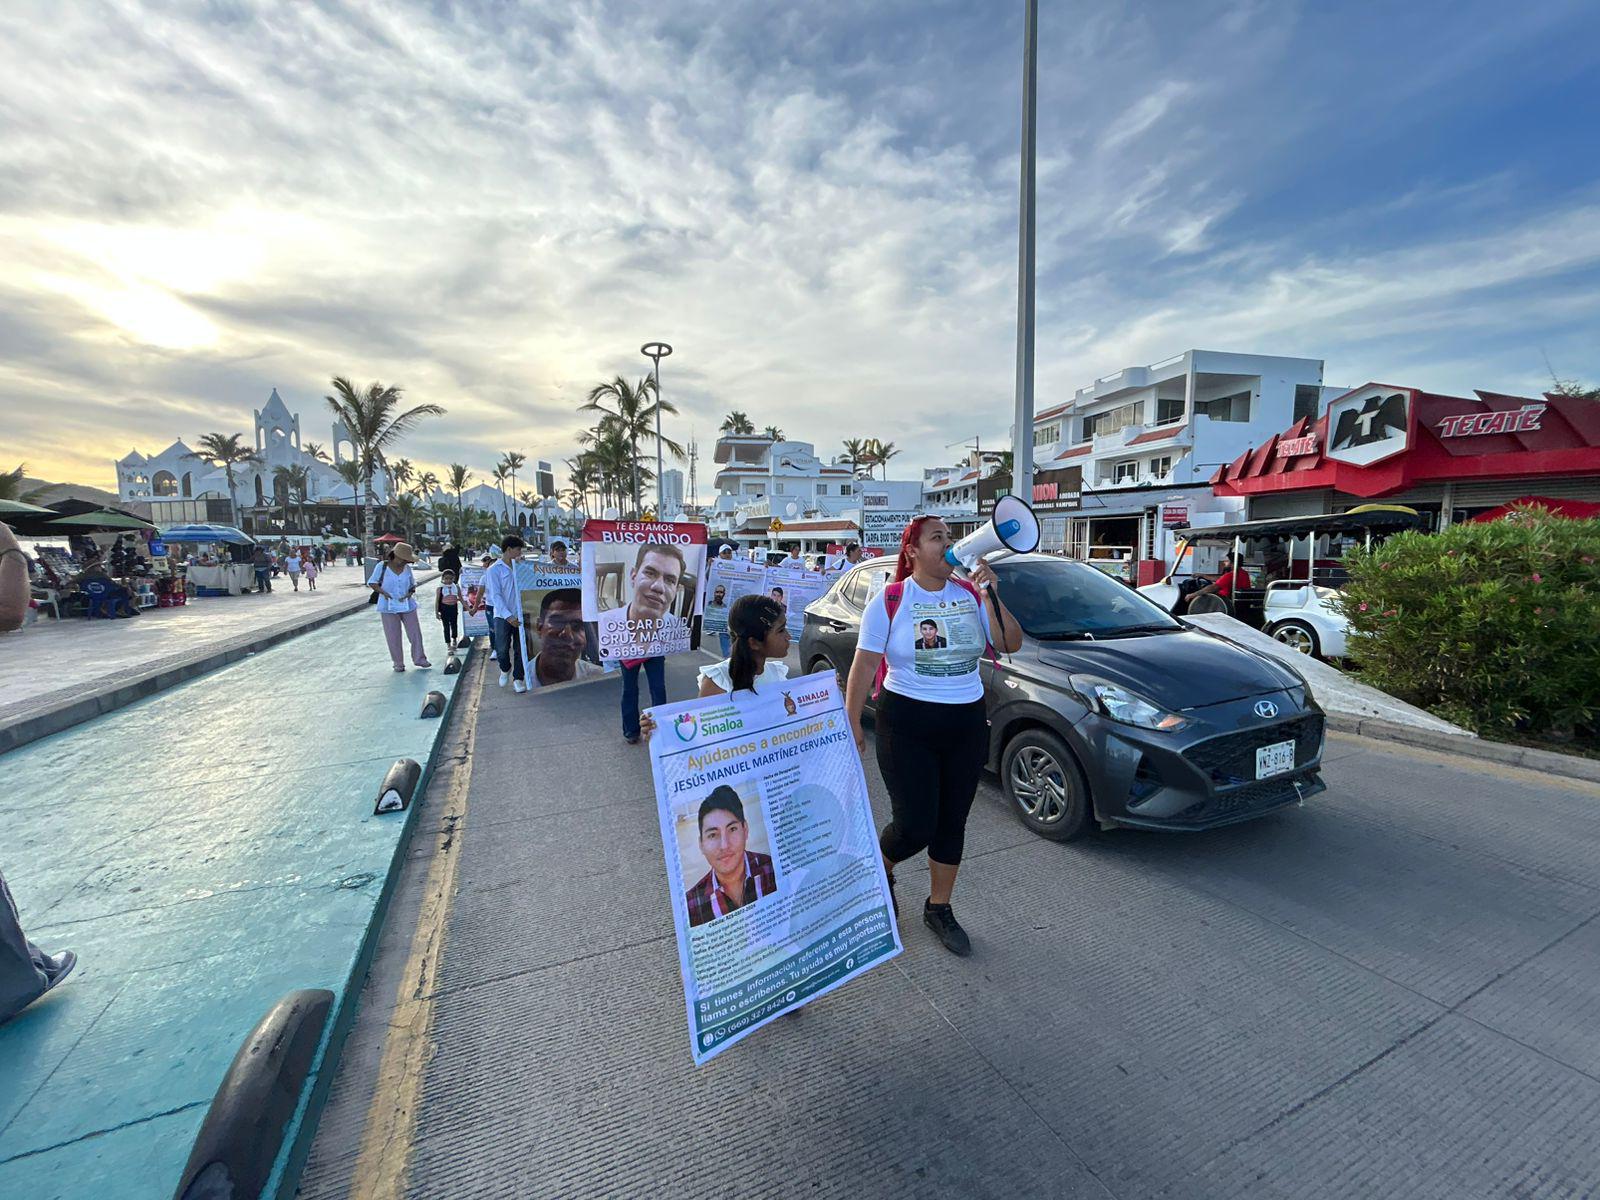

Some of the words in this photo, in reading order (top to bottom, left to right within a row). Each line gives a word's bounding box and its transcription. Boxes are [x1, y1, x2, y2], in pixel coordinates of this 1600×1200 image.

[1436, 408, 1546, 438] TECATE
[1276, 436, 1318, 458] TECATE
[616, 522, 627, 530] TE
[628, 522, 674, 532] ESTAMOS
[602, 531, 691, 545] BUSCANDO
[536, 578, 563, 587] OSCAR
[606, 618, 653, 632] OSCAR
[656, 617, 688, 630] DAVID
[600, 632, 637, 645] CRUZ
[639, 628, 692, 643] MARTINEZ
[613, 645, 645, 657] 6695
[648, 644, 662, 655] 46
[797, 689, 829, 704] SINALOA
[701, 718, 743, 737] Sinaloa
[688, 742, 757, 772] Ayúdanos
[760, 739, 768, 749] a
[772, 721, 824, 746] encontrar
[827, 719, 835, 729] a
[674, 773, 706, 793] JESÚS
[707, 761, 751, 783] MANUEL
[752, 745, 798, 769] MARTÍNEZ
[799, 730, 848, 753] CERVANTES
[700, 1002, 710, 1013] Si
[714, 989, 743, 1007] tienes
[747, 961, 796, 992] información
[798, 941, 830, 963] referente
[838, 926, 852, 939] esta
[854, 911, 886, 931] persona,
[701, 1010, 728, 1024] llama
[730, 1004, 736, 1012] o
[789, 971, 800, 981] Tu
[801, 958, 824, 976] ayuda
[824, 951, 833, 961] es
[833, 941, 848, 956] muy
[848, 922, 888, 946] importante.
[727, 1016, 750, 1034] (669)
[751, 1006, 765, 1021] 327
[766, 996, 785, 1012] 8424
